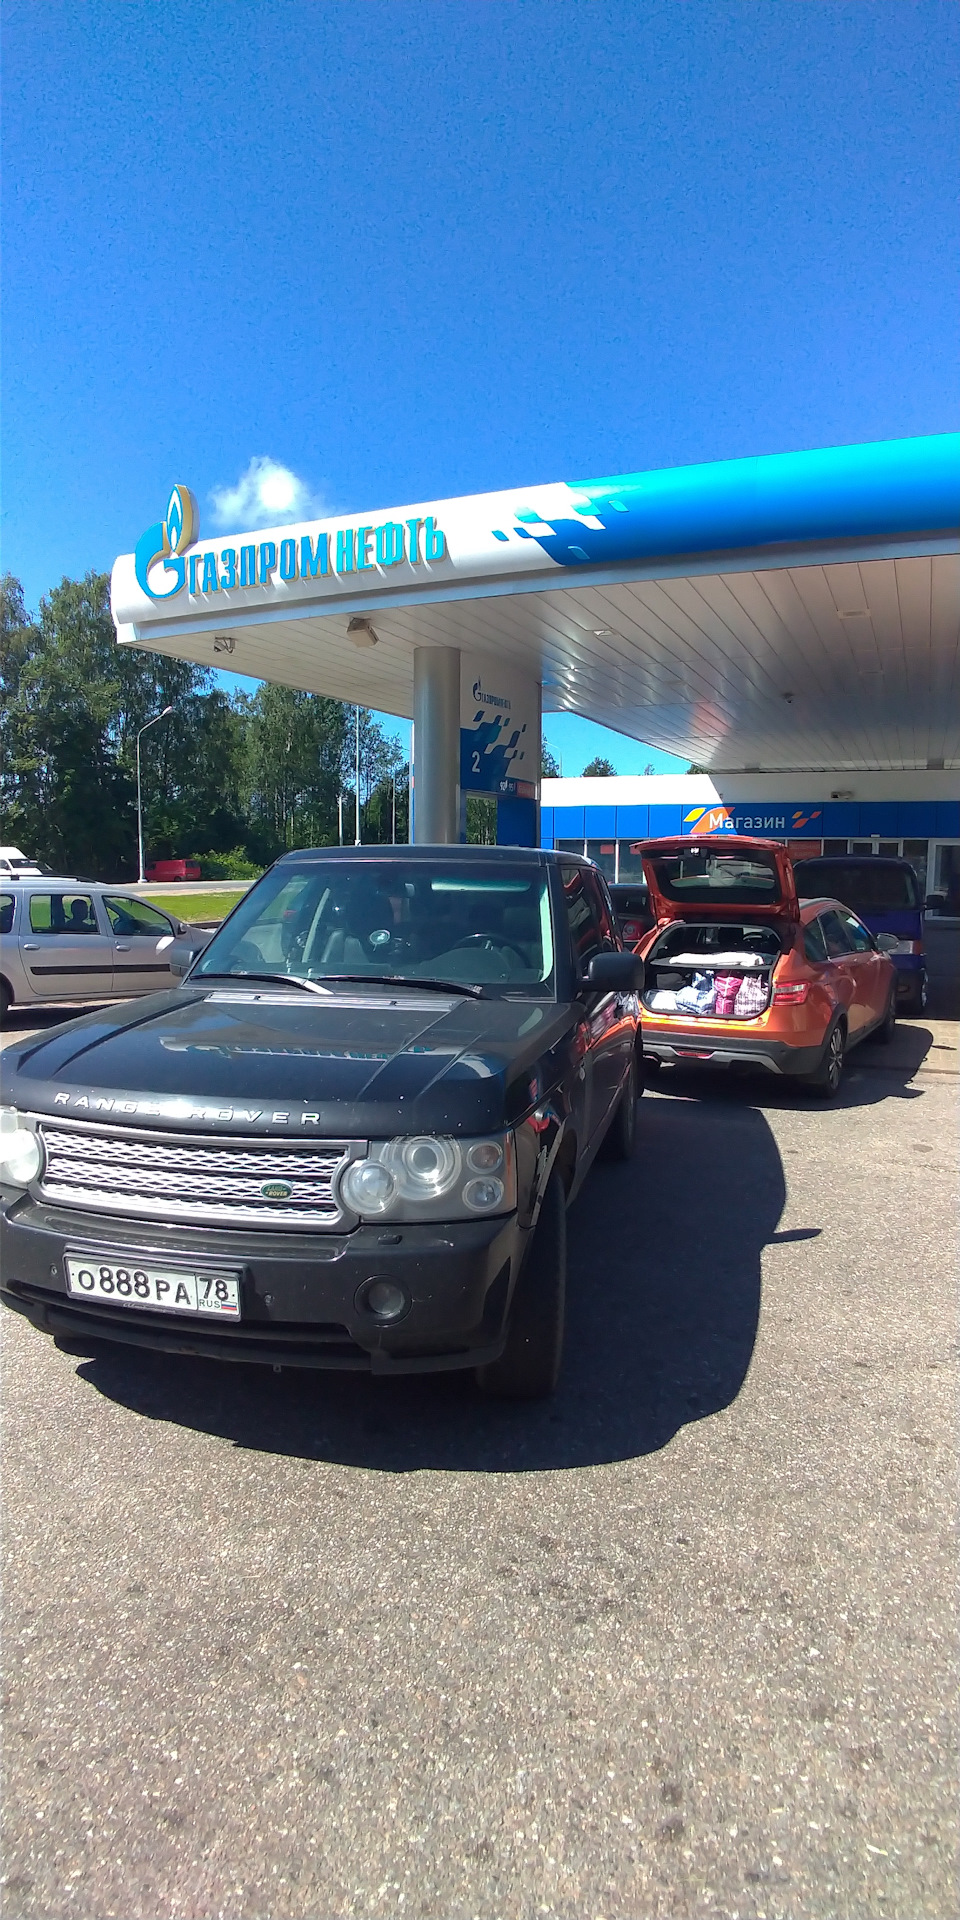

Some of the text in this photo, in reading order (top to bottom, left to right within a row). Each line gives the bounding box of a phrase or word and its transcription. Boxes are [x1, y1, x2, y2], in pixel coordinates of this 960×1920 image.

[189, 516, 449, 597] ГАЗПРОМНЕФТЬ
[471, 751, 481, 773] 2
[709, 812, 785, 829] Магазин
[54, 1091, 320, 1126] RANGE ROVER
[199, 1277, 229, 1302] 78
[199, 1299, 221, 1310] RUS
